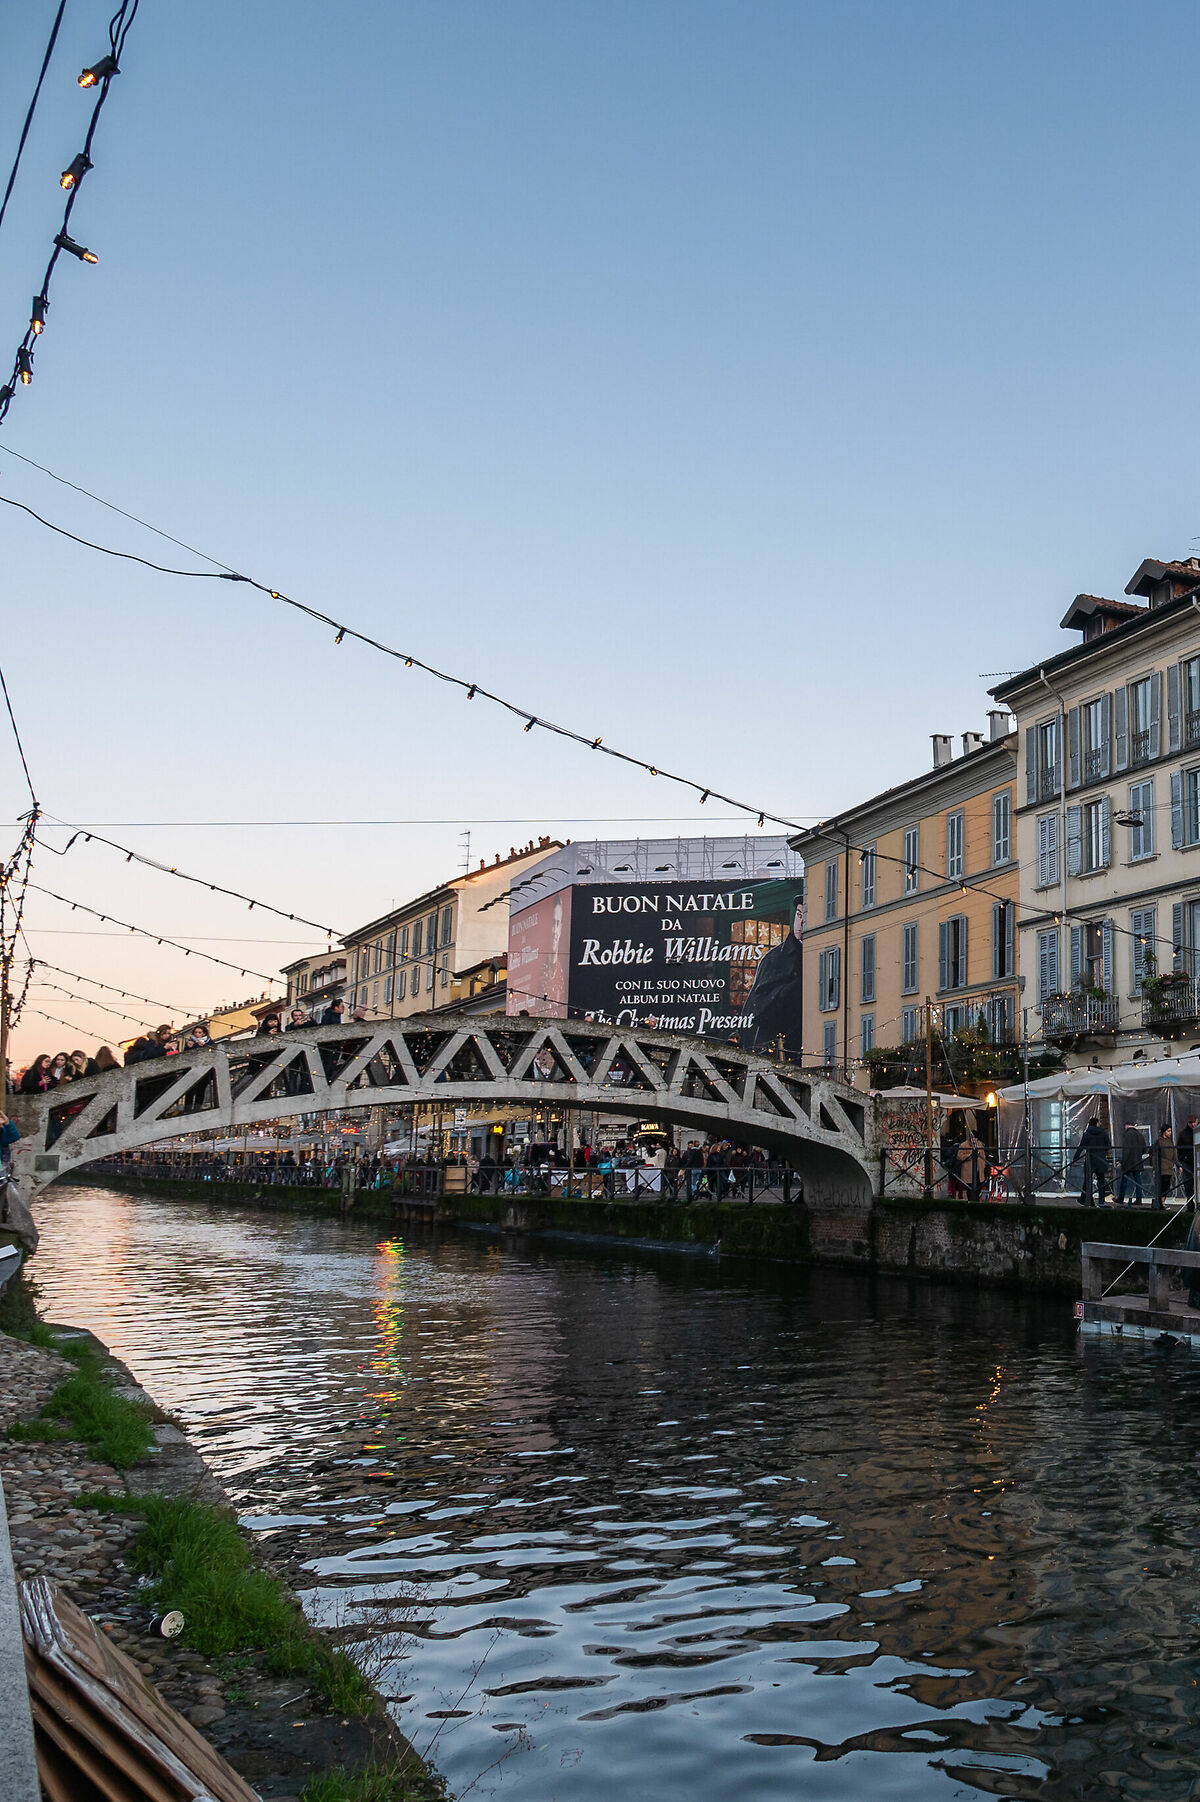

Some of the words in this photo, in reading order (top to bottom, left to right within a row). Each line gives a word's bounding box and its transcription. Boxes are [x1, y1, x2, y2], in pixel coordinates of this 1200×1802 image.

[592, 896, 660, 914] BUON
[665, 893, 754, 912] NATALE
[661, 919, 683, 931] DA
[578, 939, 654, 966] Robbie
[664, 937, 765, 964] Williams
[615, 981, 641, 991] CON
[643, 981, 654, 990] IL
[656, 980, 680, 990] SUO
[683, 979, 725, 989] NUOVO
[619, 994, 659, 1004] ALBUM
[662, 994, 674, 1003] DI
[676, 993, 720, 1003] NATALE
[616, 1008, 694, 1029] Chstmas
[696, 1007, 755, 1035] Present
